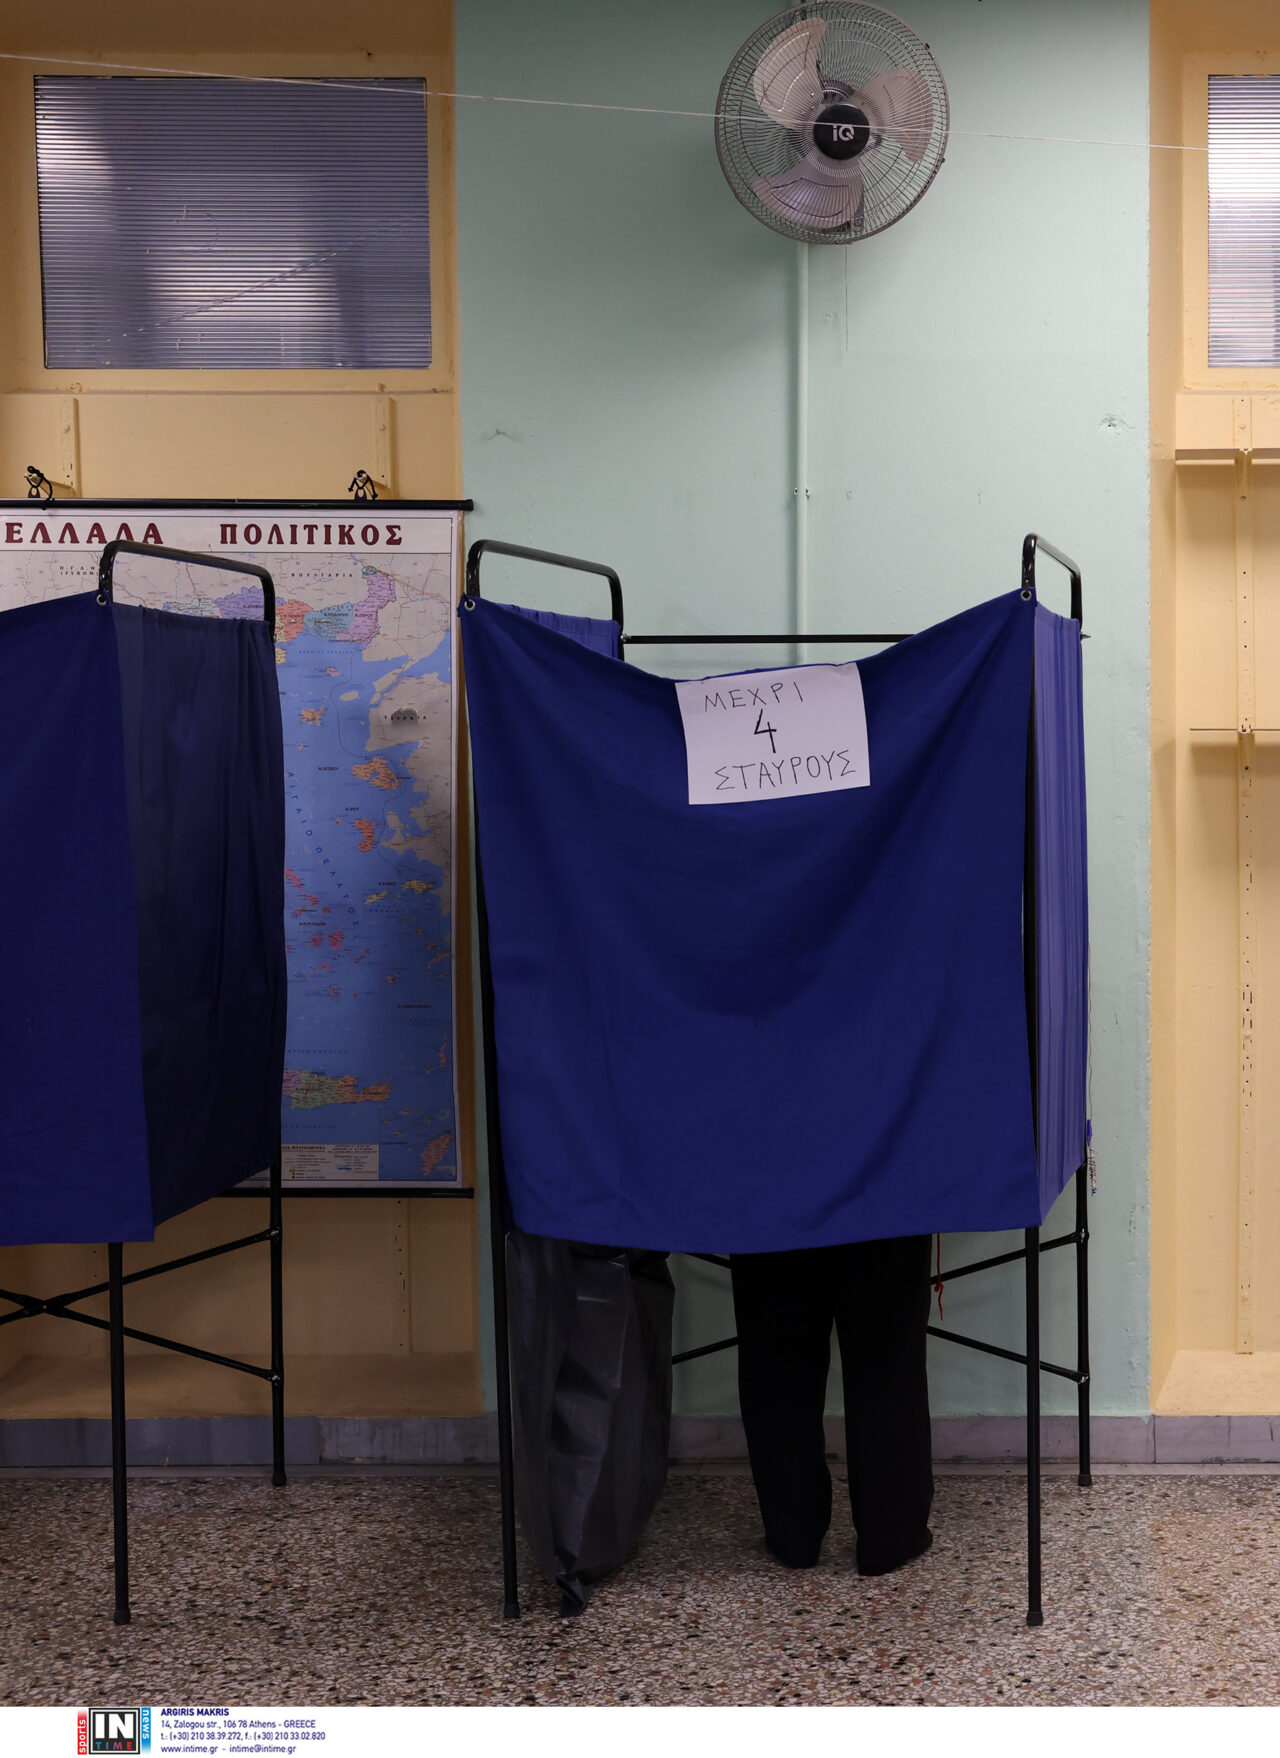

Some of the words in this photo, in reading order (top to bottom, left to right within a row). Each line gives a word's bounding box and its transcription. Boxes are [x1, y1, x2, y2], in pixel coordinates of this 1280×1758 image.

[220, 523, 402, 546] ΠΟΛΙΤΙΚΟΣ
[704, 681, 803, 712] ΜΕΧΡΙ
[753, 708, 777, 753] 4
[714, 750, 857, 791] ΣΤΑΥΡΟΥΣ
